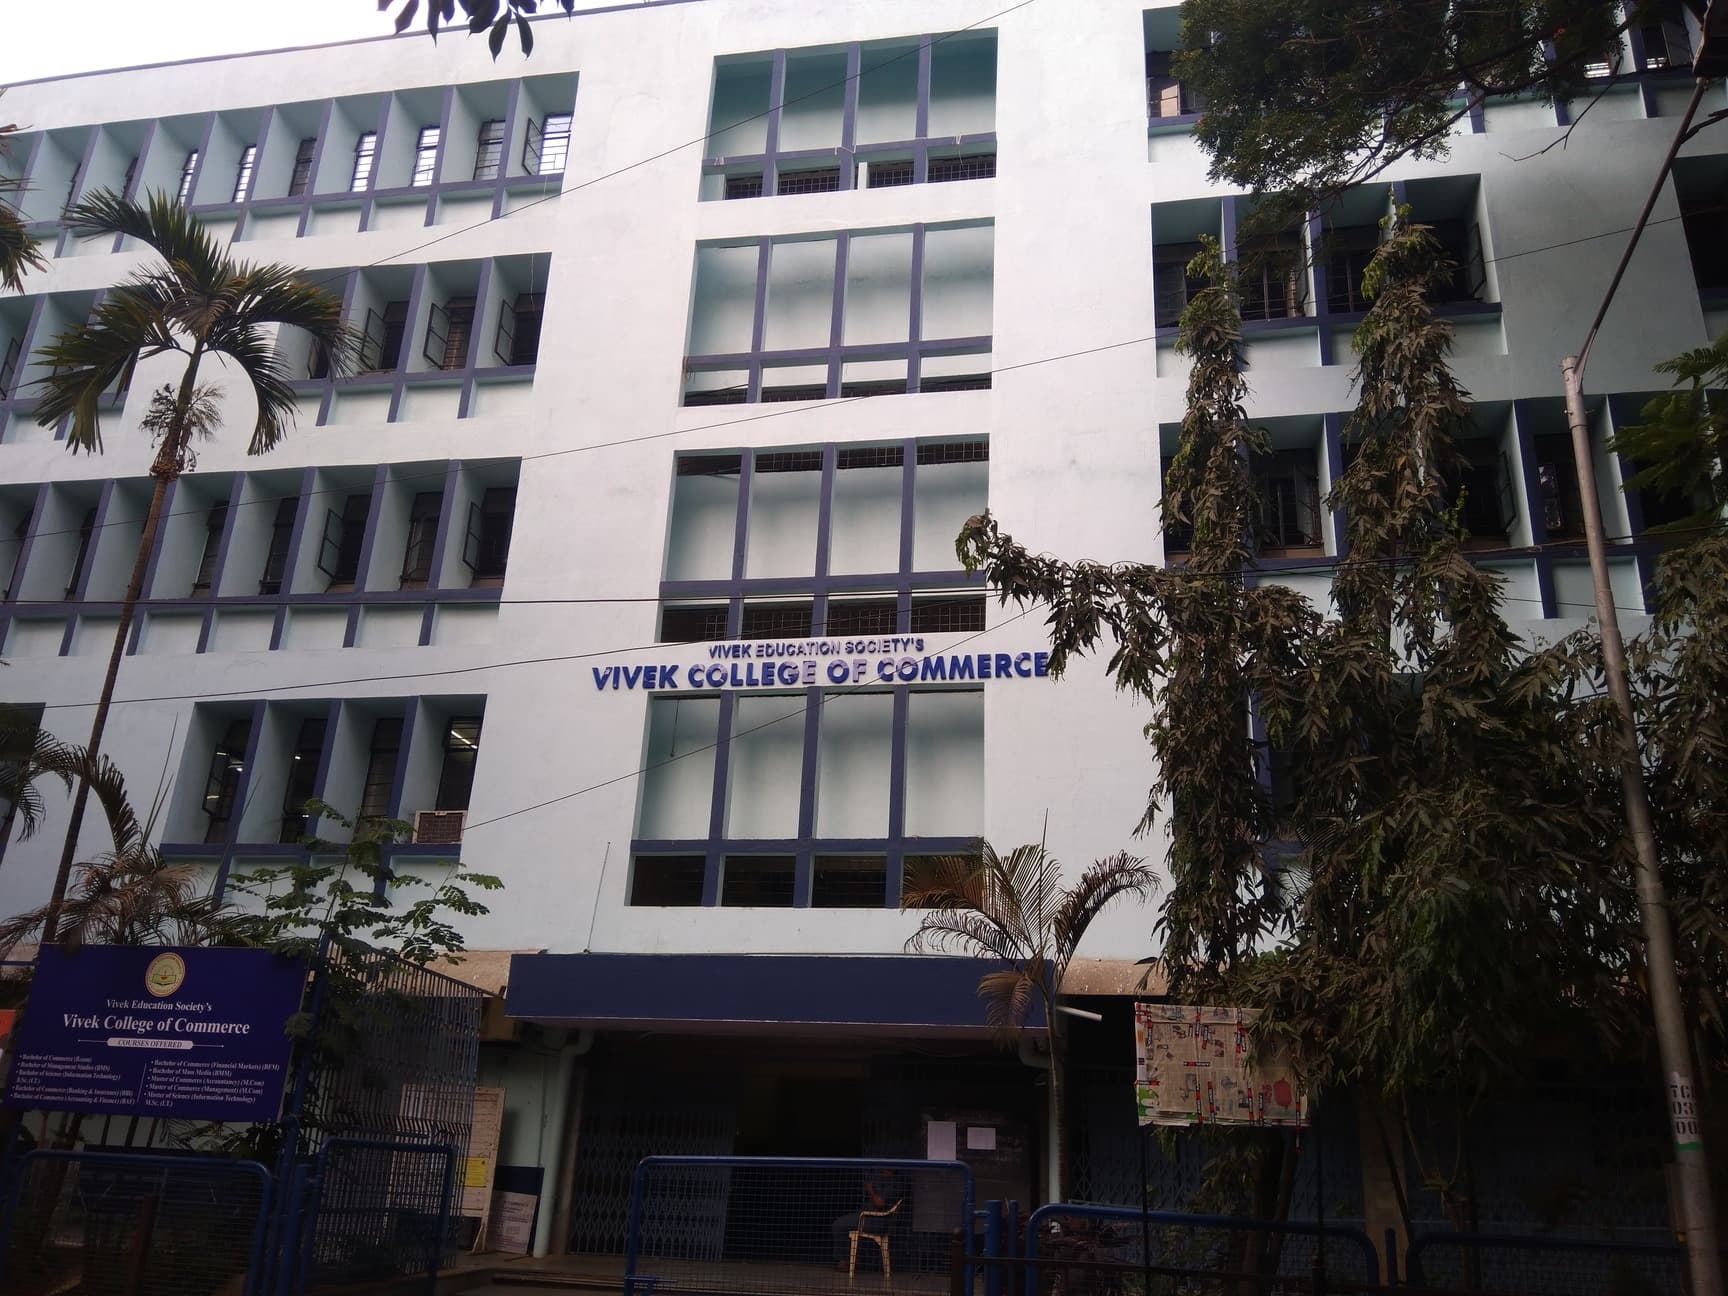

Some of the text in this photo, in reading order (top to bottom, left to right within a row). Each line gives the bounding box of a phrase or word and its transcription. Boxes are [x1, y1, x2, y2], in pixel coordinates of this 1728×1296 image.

[709, 637, 924, 659] VIVEK EDUCATION SOCIETY'S
[592, 652, 1049, 689] VIVEK COLLEGE OF COMMERCE
[106, 999, 212, 1014] Vivek Education Society's
[63, 1013, 250, 1035] Vivek College of Commerce
[117, 1039, 182, 1049] COURSES OFFERED
